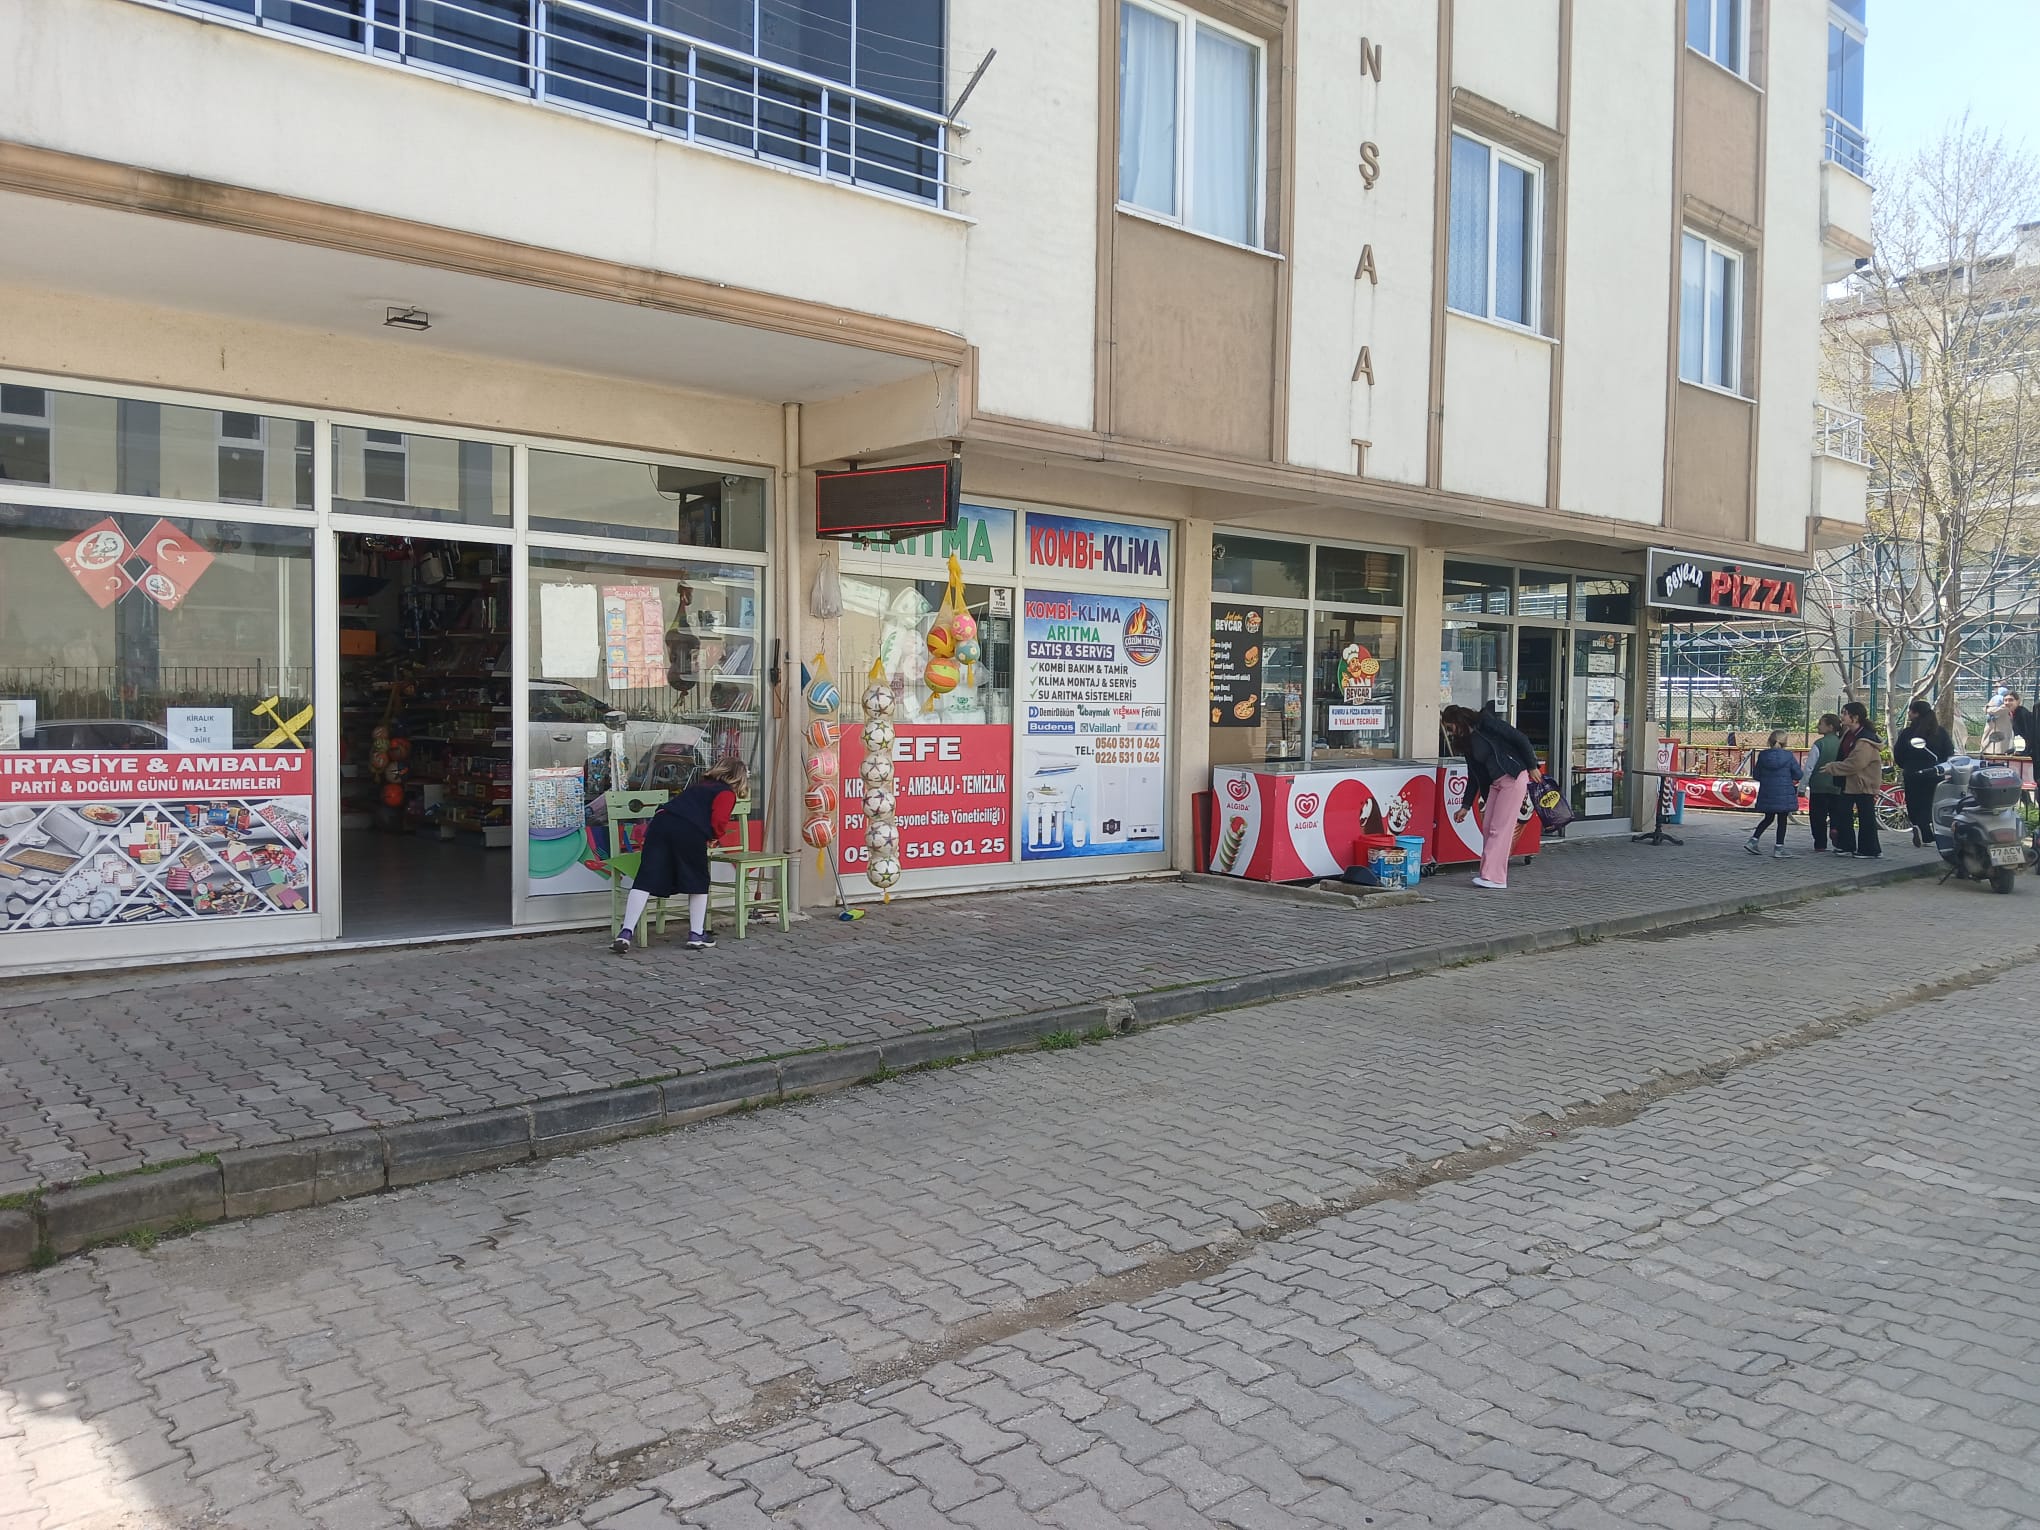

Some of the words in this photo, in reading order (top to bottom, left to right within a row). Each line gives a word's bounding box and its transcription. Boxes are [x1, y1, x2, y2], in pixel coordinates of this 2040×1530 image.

[1046, 624, 1101, 643] ARITMA
[1030, 642, 1062, 659] SATIŞ
[1064, 645, 1073, 657] &
[1039, 661, 1066, 673] KOMBİ
[1068, 663, 1095, 674] BAKIM
[1096, 665, 1103, 674] &
[1104, 664, 1129, 675] TAMİR
[1038, 674, 1065, 687] KLİMA
[1067, 677, 1100, 688] MONTAJ
[1101, 679, 1108, 688] &
[1109, 678, 1137, 689] SERVİS
[1038, 689, 1050, 701] SU
[1051, 690, 1083, 701] ARITMA
[1085, 690, 1132, 702] SİSTEMLERİ
[1346, 687, 1370, 700] BEYCAR
[186, 713, 215, 722] KİRALIK
[1029, 722, 1075, 732] Buderus
[1088, 723, 1121, 733] Vaillant
[189, 735, 212, 744] DAİRE
[1075, 746, 1095, 756] TEL:
[1095, 737, 1118, 749] 0540
[1119, 737, 1135, 749] 531
[1136, 737, 1143, 749] 0
[1144, 737, 1160, 749] 424
[892, 736, 962, 762] EFE
[1095, 751, 1118, 764] 0226
[1119, 751, 1135, 764] 531
[1136, 751, 1143, 763] 0
[1144, 751, 1160, 763] 424
[146, 757, 169, 773] &
[176, 757, 302, 773] AMBALAJ
[11, 777, 56, 794] PARTİ
[60, 779, 73, 793] &
[76, 775, 133, 793] DOĞUM
[139, 775, 178, 792] GÜNÜ
[181, 774, 281, 791] MALZEMELERİ
[907, 775, 955, 796] AMBALAJ
[961, 769, 1006, 794] TEMİZLİK
[1446, 797, 1464, 806] ALGI
[845, 813, 865, 829] PSY
[930, 811, 950, 825] Site
[951, 807, 1000, 826] Yöneticiliği
[906, 841, 945, 858] 518
[950, 840, 976, 855] 01
[980, 838, 1005, 854] 25
[1991, 848, 2002, 857] 77
